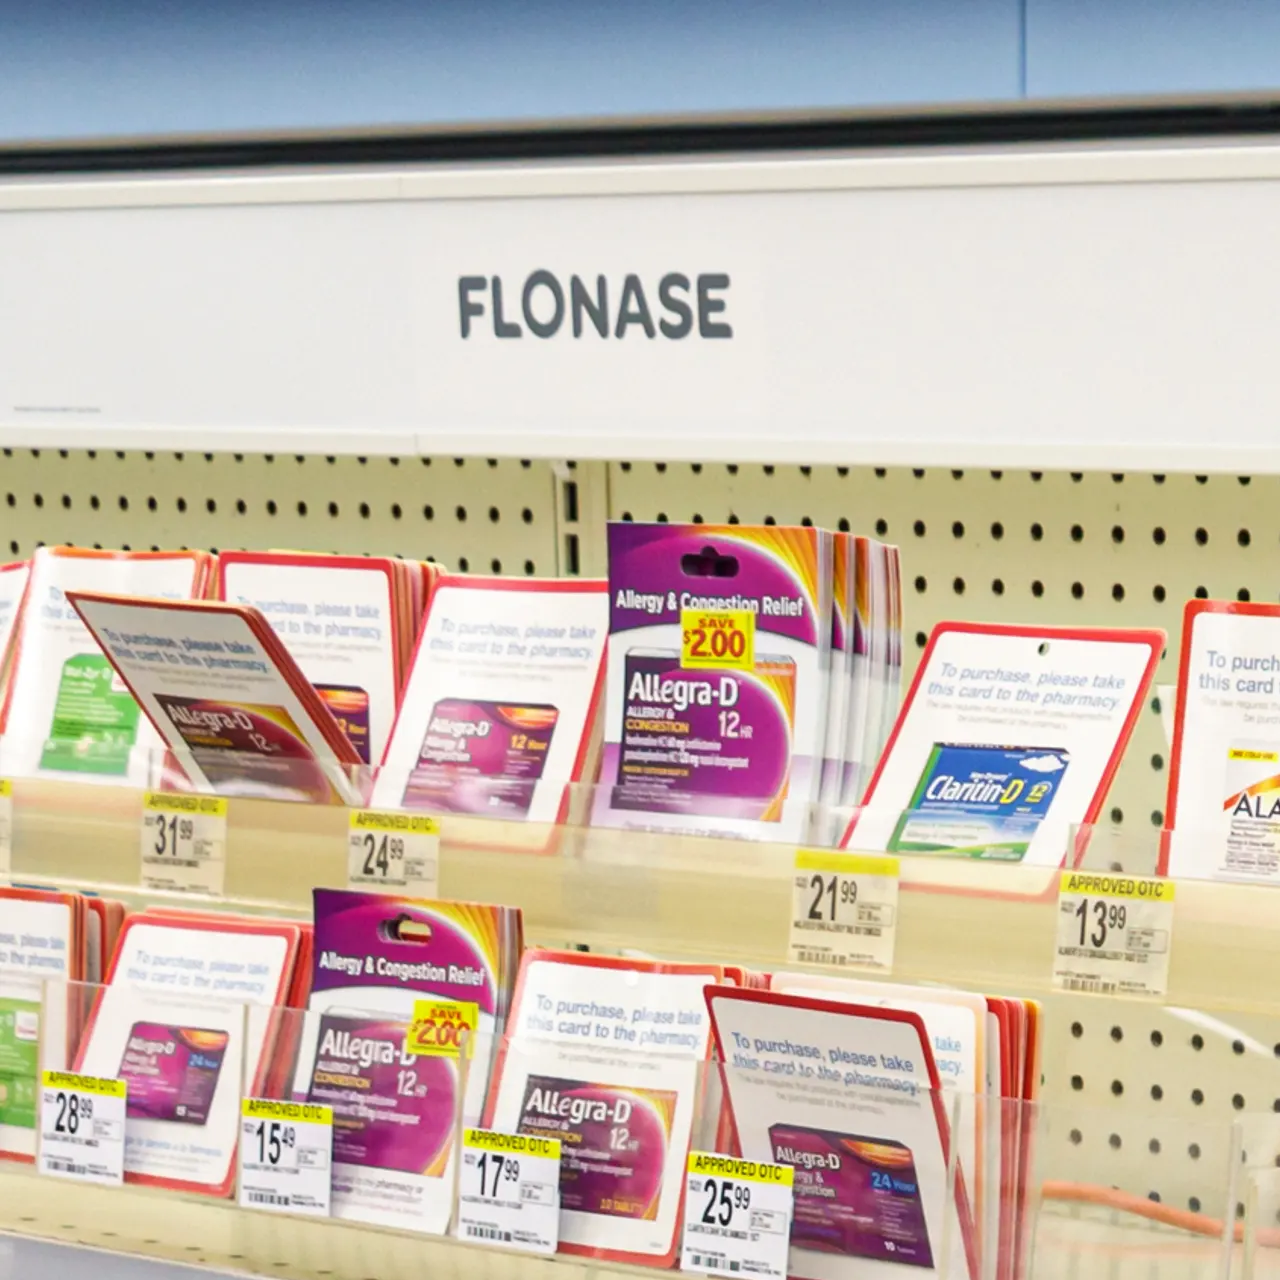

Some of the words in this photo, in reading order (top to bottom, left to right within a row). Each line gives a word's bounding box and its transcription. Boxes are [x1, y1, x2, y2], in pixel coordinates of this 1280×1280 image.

[457, 270, 732, 339] FLONASE
[616, 590, 663, 615] Allergy
[666, 592, 676, 611] &
[762, 595, 803, 616] Relief
[698, 618, 734, 629] SAVE
[683, 630, 746, 660] $2.00
[629, 672, 738, 706] Allegra-D
[1068, 876, 1135, 894] APPROVED
[1138, 883, 1164, 898] OTC
[320, 954, 361, 976] Allergy
[364, 958, 374, 974] &
[377, 959, 444, 982] Congestion
[448, 966, 485, 986] Relief
[527, 1089, 630, 1124] Allegra-D
